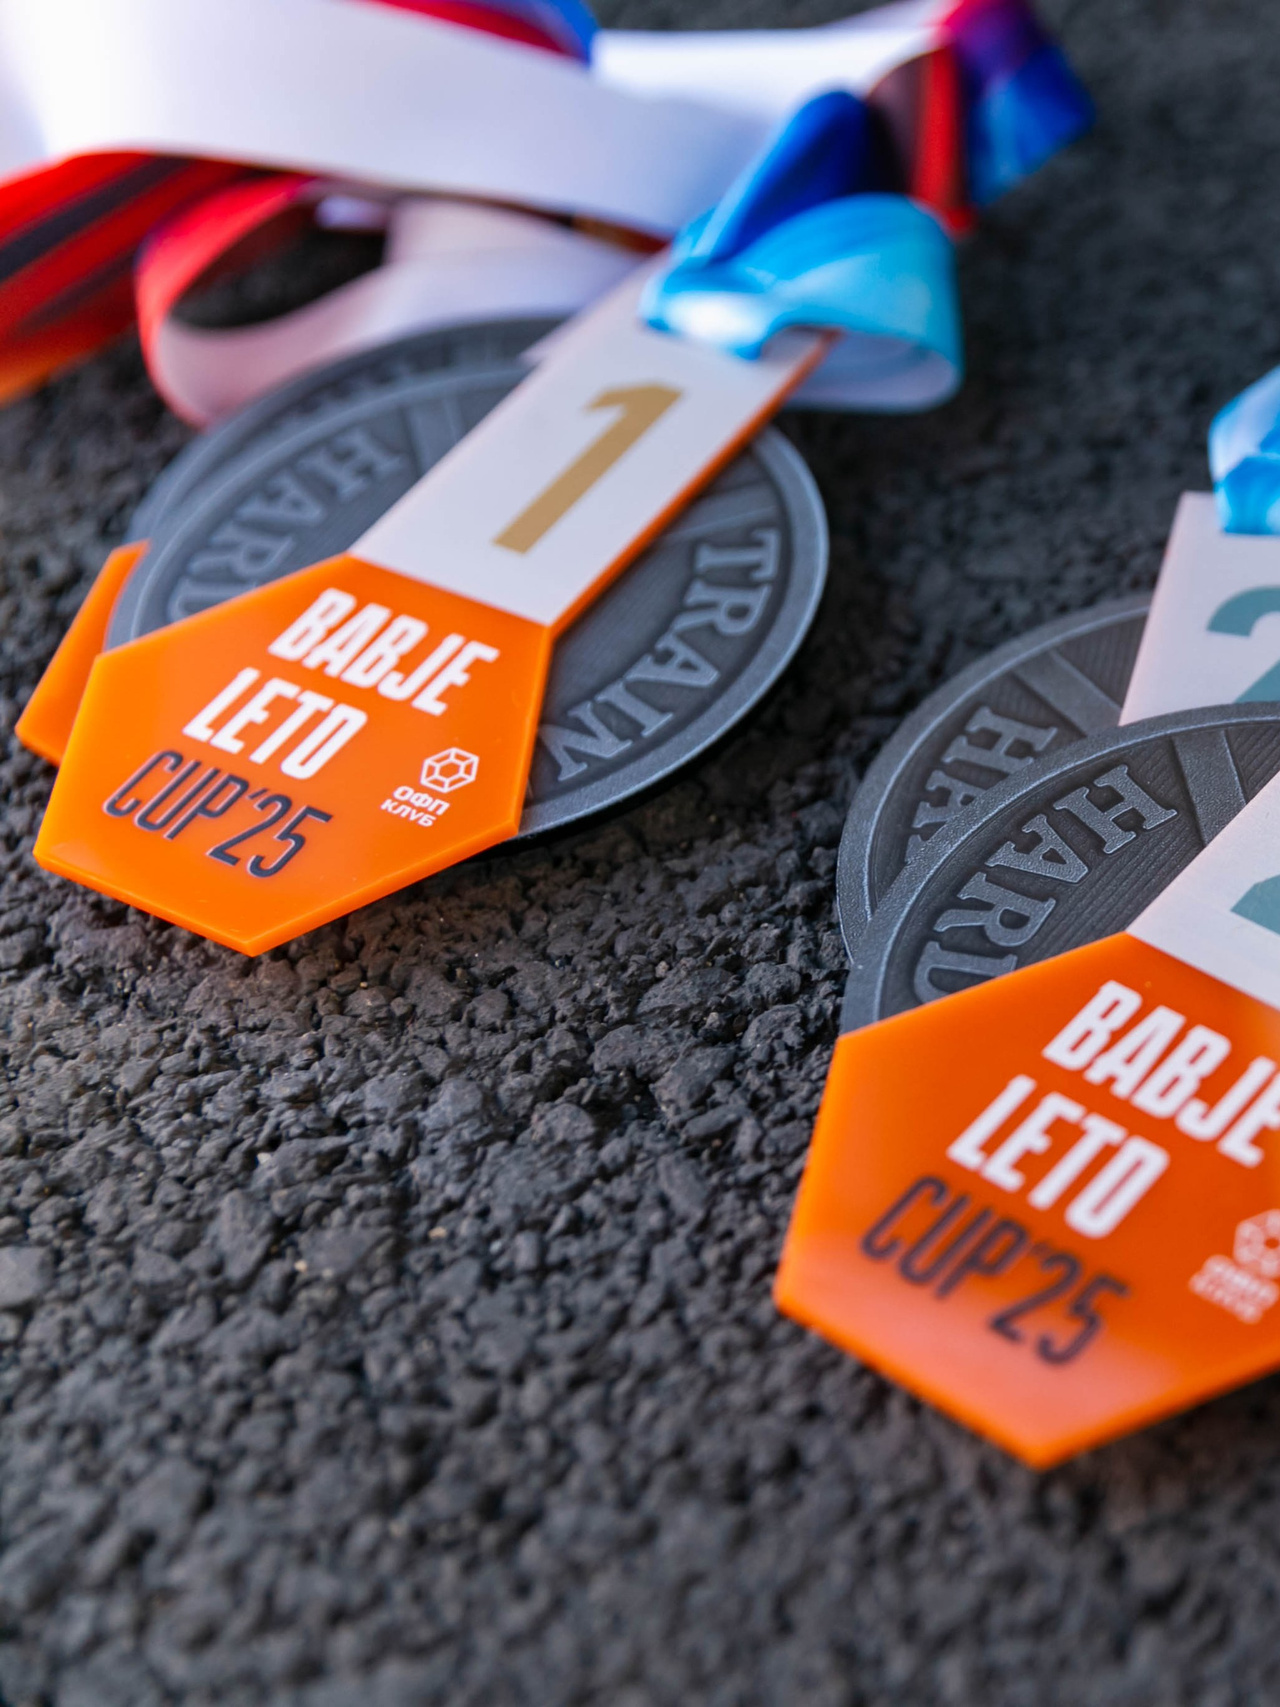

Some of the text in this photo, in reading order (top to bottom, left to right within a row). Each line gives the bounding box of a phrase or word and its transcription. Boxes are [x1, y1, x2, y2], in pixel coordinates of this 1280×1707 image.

[492, 383, 683, 554] 1
[181, 666, 368, 780] LETO
[266, 587, 500, 716] BABJE
[539, 528, 780, 781] TRAIN
[103, 750, 334, 878] CUP'25
[380, 798, 437, 827] КЛУБ
[393, 785, 450, 816] ОФП
[905, 706, 1057, 865] HA
[913, 764, 1178, 1005] HARD
[946, 1073, 1170, 1239] LETO
